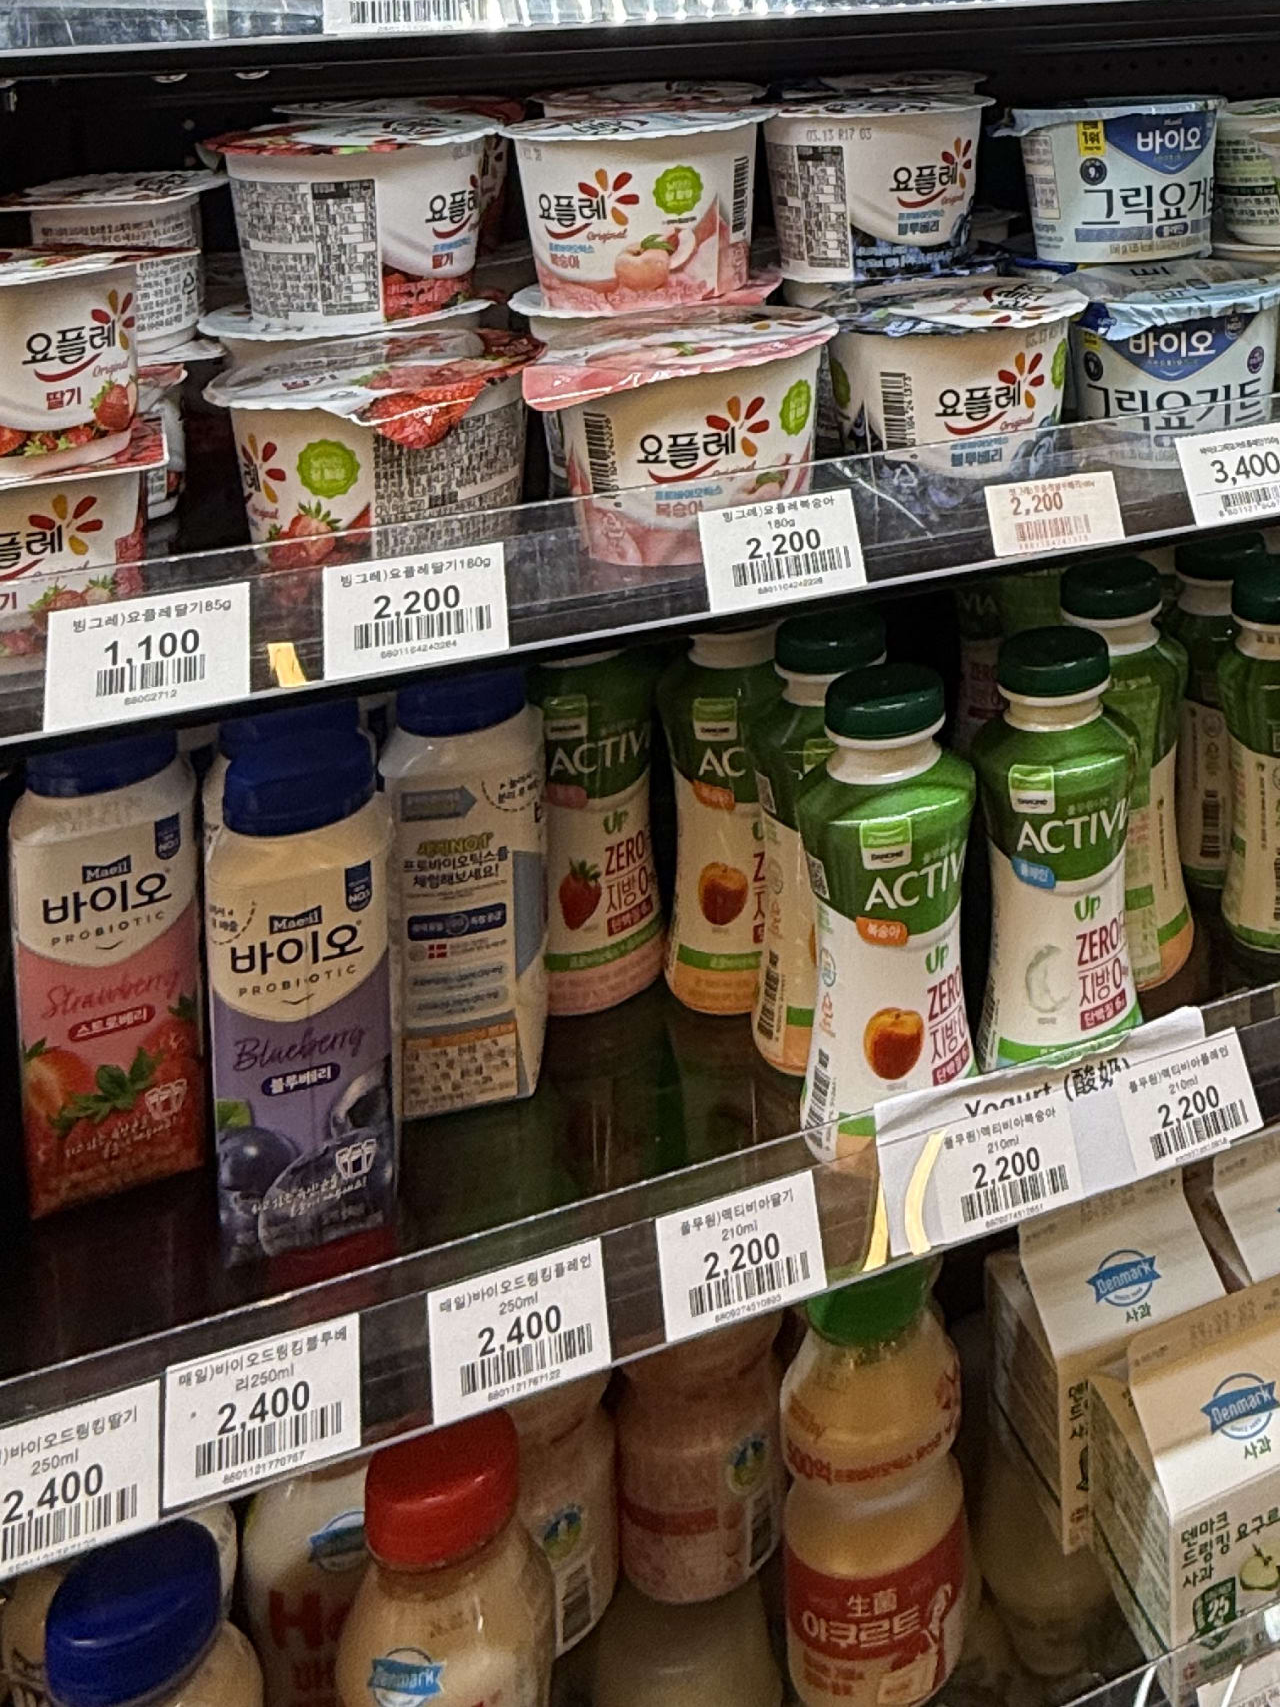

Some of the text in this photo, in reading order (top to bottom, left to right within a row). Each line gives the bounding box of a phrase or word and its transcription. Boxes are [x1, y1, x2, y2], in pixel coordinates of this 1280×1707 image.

[1136, 126, 1201, 154] 바이오
[889, 163, 958, 194] 요플레
[538, 192, 608, 226] 요플레
[22, 315, 117, 367] 요플레
[1128, 331, 1215, 358] 바이오
[45, 386, 82, 410] 딸기
[935, 383, 1022, 420] 요플레
[636, 428, 736, 467] 요플레
[1210, 451, 1280, 485] 3,400
[1010, 493, 1063, 516] 2,200
[746, 528, 822, 561] 2,200
[373, 584, 461, 622] 2,200
[104, 628, 200, 667] 1,100
[605, 829, 645, 875] ZERO
[83, 857, 131, 883] Maeil
[42, 872, 172, 924] 바이오
[51, 910, 165, 947] PROBIOTIC
[270, 907, 322, 933] Maeil
[867, 923, 901, 940] 복숭아
[229, 924, 364, 977] 바이오
[1076, 917, 1119, 966] ZERO
[238, 964, 356, 997] PROBIOTIC
[75, 1007, 148, 1039] 스트로베리
[233, 1024, 366, 1072] Blueberry
[1157, 1085, 1220, 1128] 2,200
[973, 1147, 1040, 1189] 2,200
[703, 1233, 781, 1280] 2,200
[1097, 1261, 1153, 1293] Denmark
[1125, 1302, 1152, 1323] 사과
[477, 1304, 562, 1360] 2,400
[217, 1380, 311, 1437] 2,400
[1210, 1387, 1275, 1423] Denmark
[30, 1448, 79, 1477] 250ml
[1243, 1436, 1271, 1460] 사과
[2, 1463, 103, 1524] 2,400
[1180, 1512, 1229, 1546] 덴마크
[1181, 1533, 1230, 1569] 드링킹
[1182, 1565, 1214, 1589] 사과
